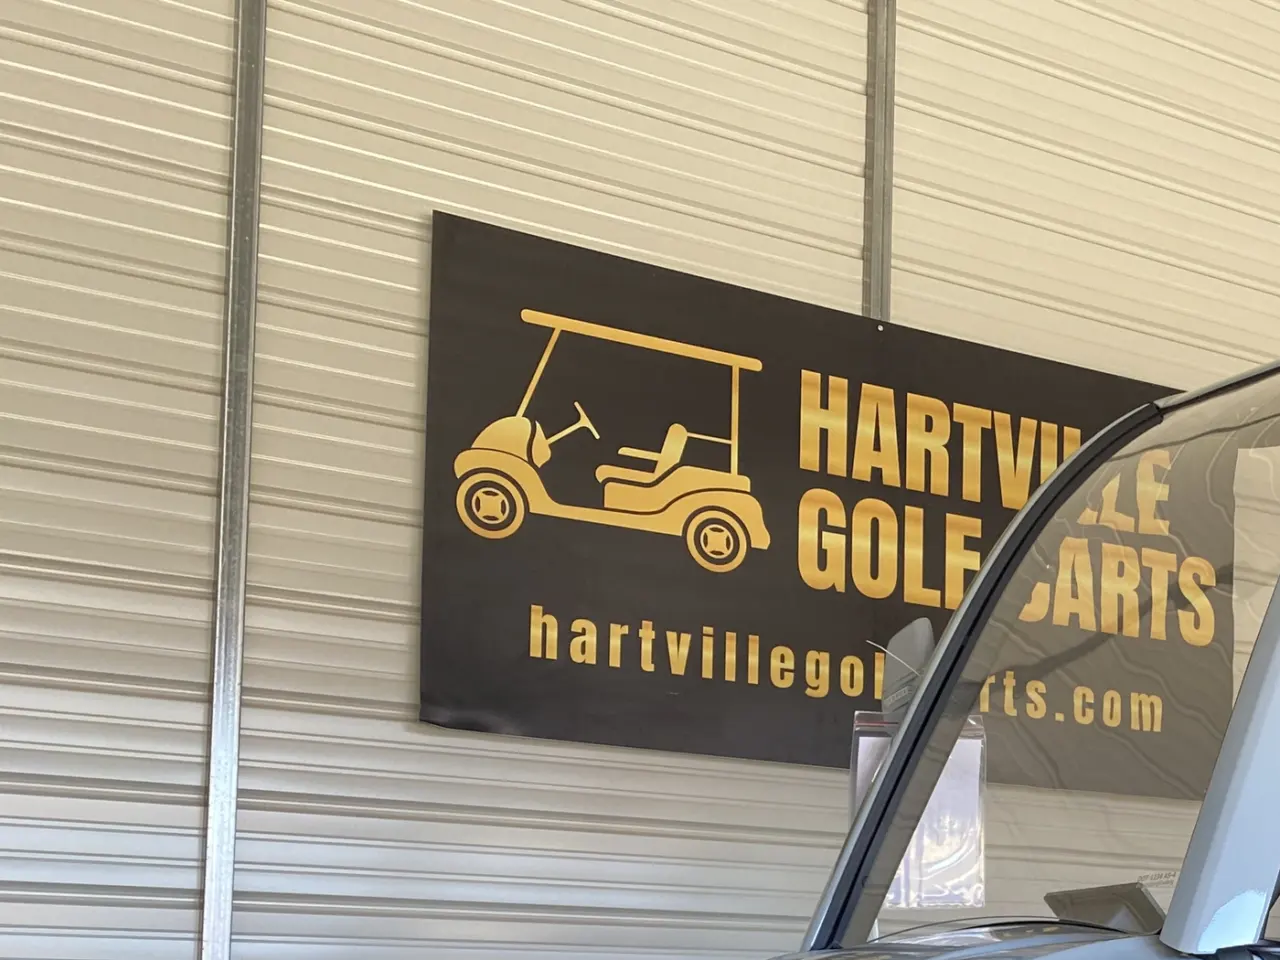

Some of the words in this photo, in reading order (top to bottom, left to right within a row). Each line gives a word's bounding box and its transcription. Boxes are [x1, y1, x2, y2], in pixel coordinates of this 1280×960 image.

[798, 487, 982, 611] GOLF
[1018, 536, 1217, 647] ARTS
[529, 604, 1163, 733] hartvillegolrts.com
